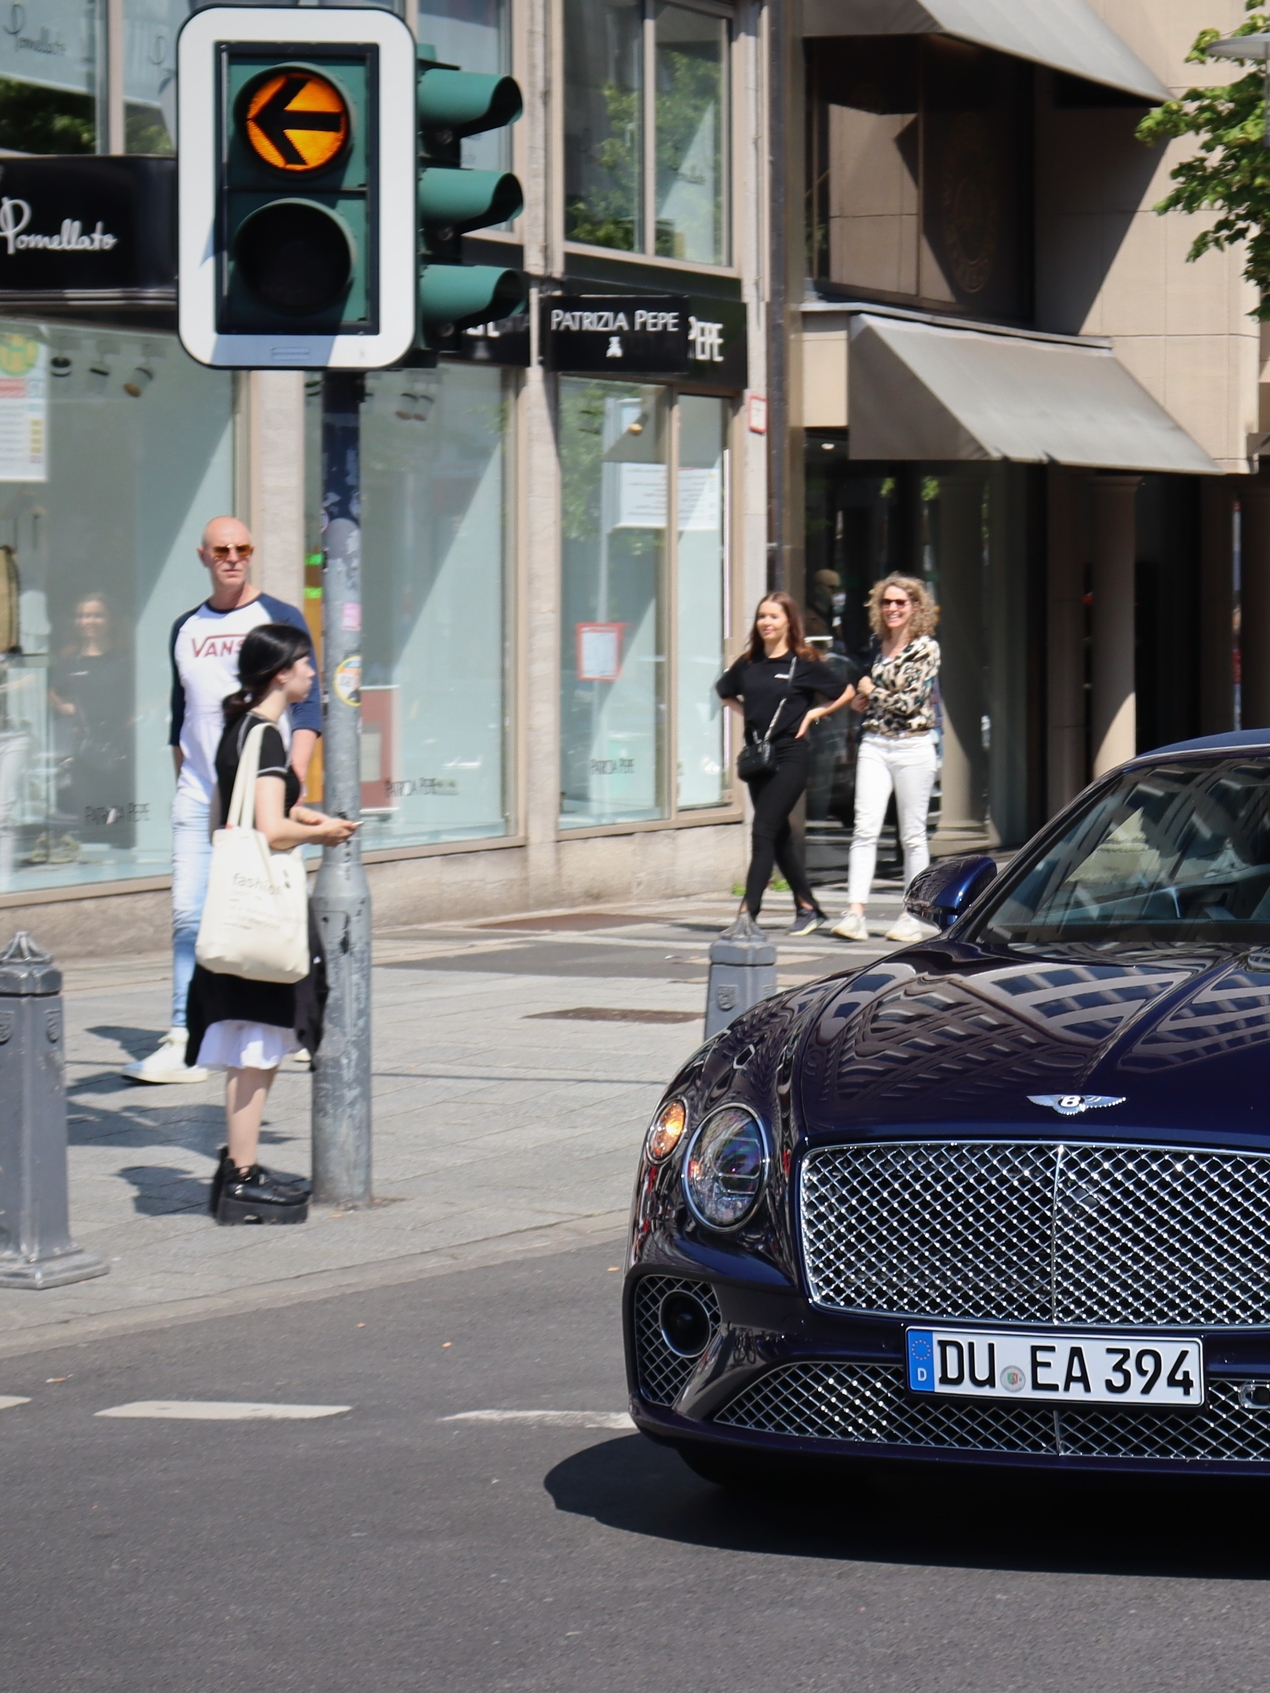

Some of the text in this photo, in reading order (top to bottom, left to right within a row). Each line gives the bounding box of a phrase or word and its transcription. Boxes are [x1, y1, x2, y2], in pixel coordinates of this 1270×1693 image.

[0, 196, 118, 255] Pomellato
[551, 309, 630, 332] PATRIZIA
[634, 310, 680, 332] PEPE
[917, 1367, 927, 1382] D
[937, 1339, 1194, 1396] DU EA 394
